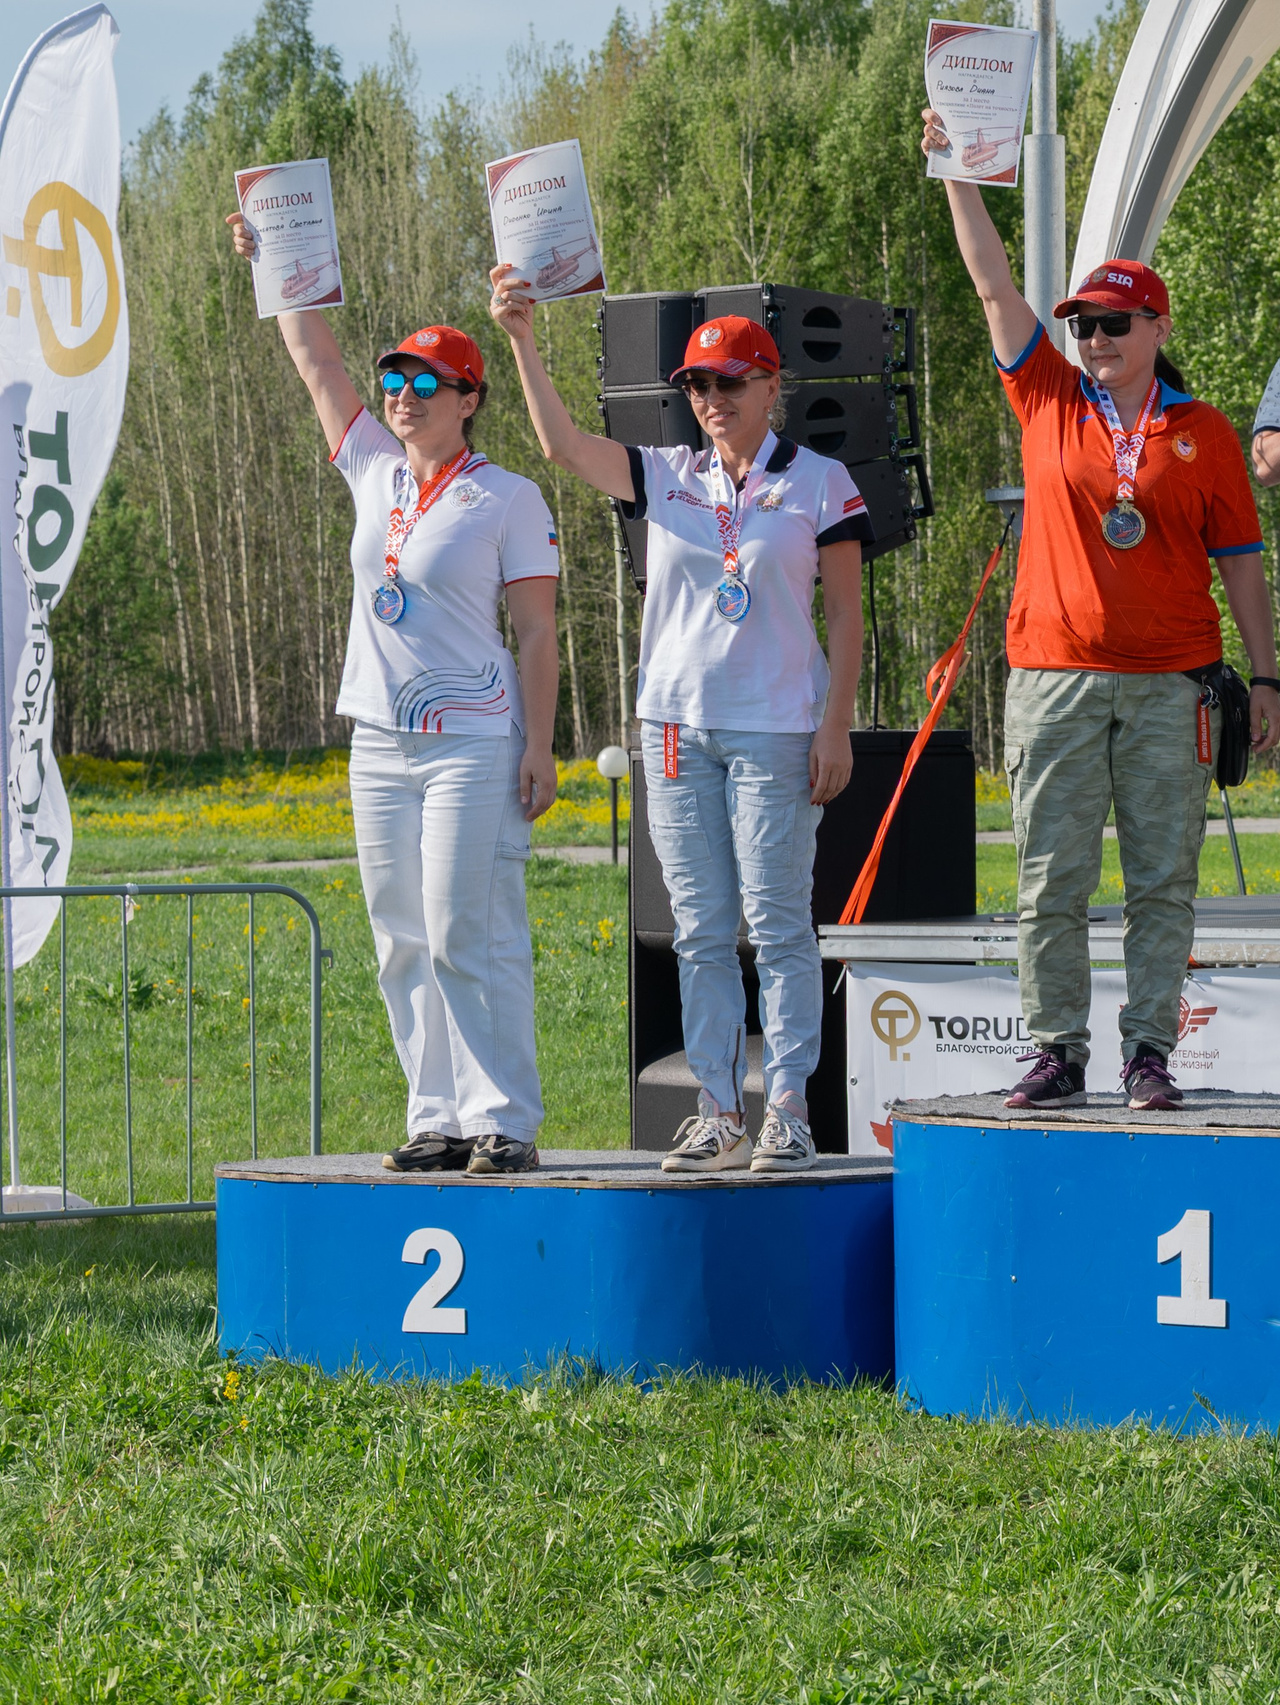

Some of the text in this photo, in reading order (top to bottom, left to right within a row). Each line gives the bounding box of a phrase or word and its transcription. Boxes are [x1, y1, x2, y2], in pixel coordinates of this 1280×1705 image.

[942, 54, 1014, 74] ДИПЛОМ
[503, 175, 567, 205] ДИПЛОМ
[252, 191, 314, 215] ДИПЛОМ
[449, 458, 466, 477] ГОНКИ
[675, 494, 714, 510] HELICOPTERS
[677, 490, 702, 503] RUSSIAN
[667, 723, 675, 756] ELICOPTER
[927, 1015, 1033, 1042] TORUD
[1180, 1060, 1214, 1070] ЖИЗНИ
[401, 1227, 466, 1334] 2
[1157, 1209, 1226, 1328] 1
